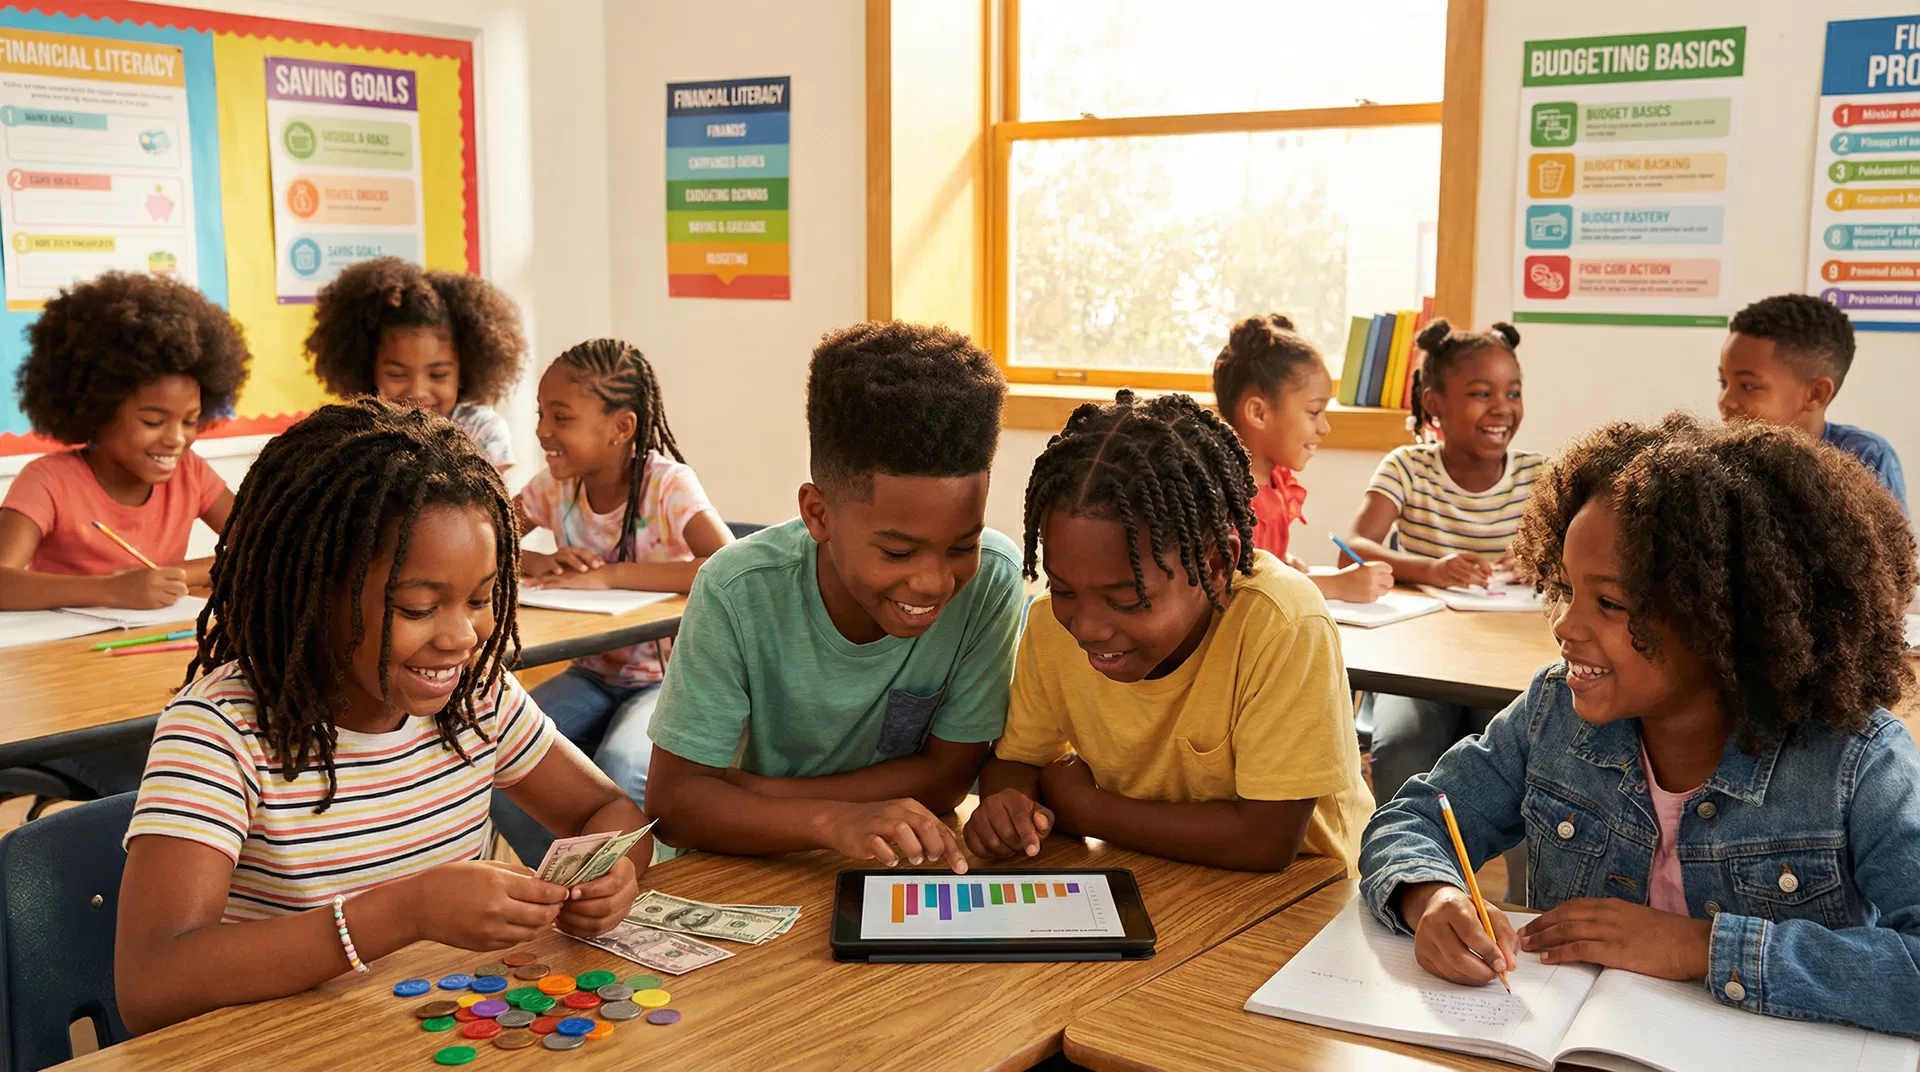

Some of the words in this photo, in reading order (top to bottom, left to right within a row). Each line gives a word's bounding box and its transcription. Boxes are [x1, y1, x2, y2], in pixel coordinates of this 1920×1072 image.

[0, 37, 92, 72] FINANCIAL
[94, 48, 177, 78] LITERACY
[1531, 44, 1650, 77] BUDGETING
[1655, 38, 1736, 70] BASICS
[275, 64, 347, 99] SAVING
[351, 71, 409, 105] GOALS
[674, 87, 730, 109] FINANCIAL
[731, 84, 784, 106] LITERACY
[6, 108, 13, 124] 1
[1586, 106, 1630, 121] BUDGET
[1631, 104, 1672, 119] BASICS
[1841, 107, 1849, 124] 1
[1839, 135, 1849, 152] 2
[11, 171, 22, 188] 2
[1836, 163, 1846, 180] 3
[1834, 191, 1844, 207] 4
